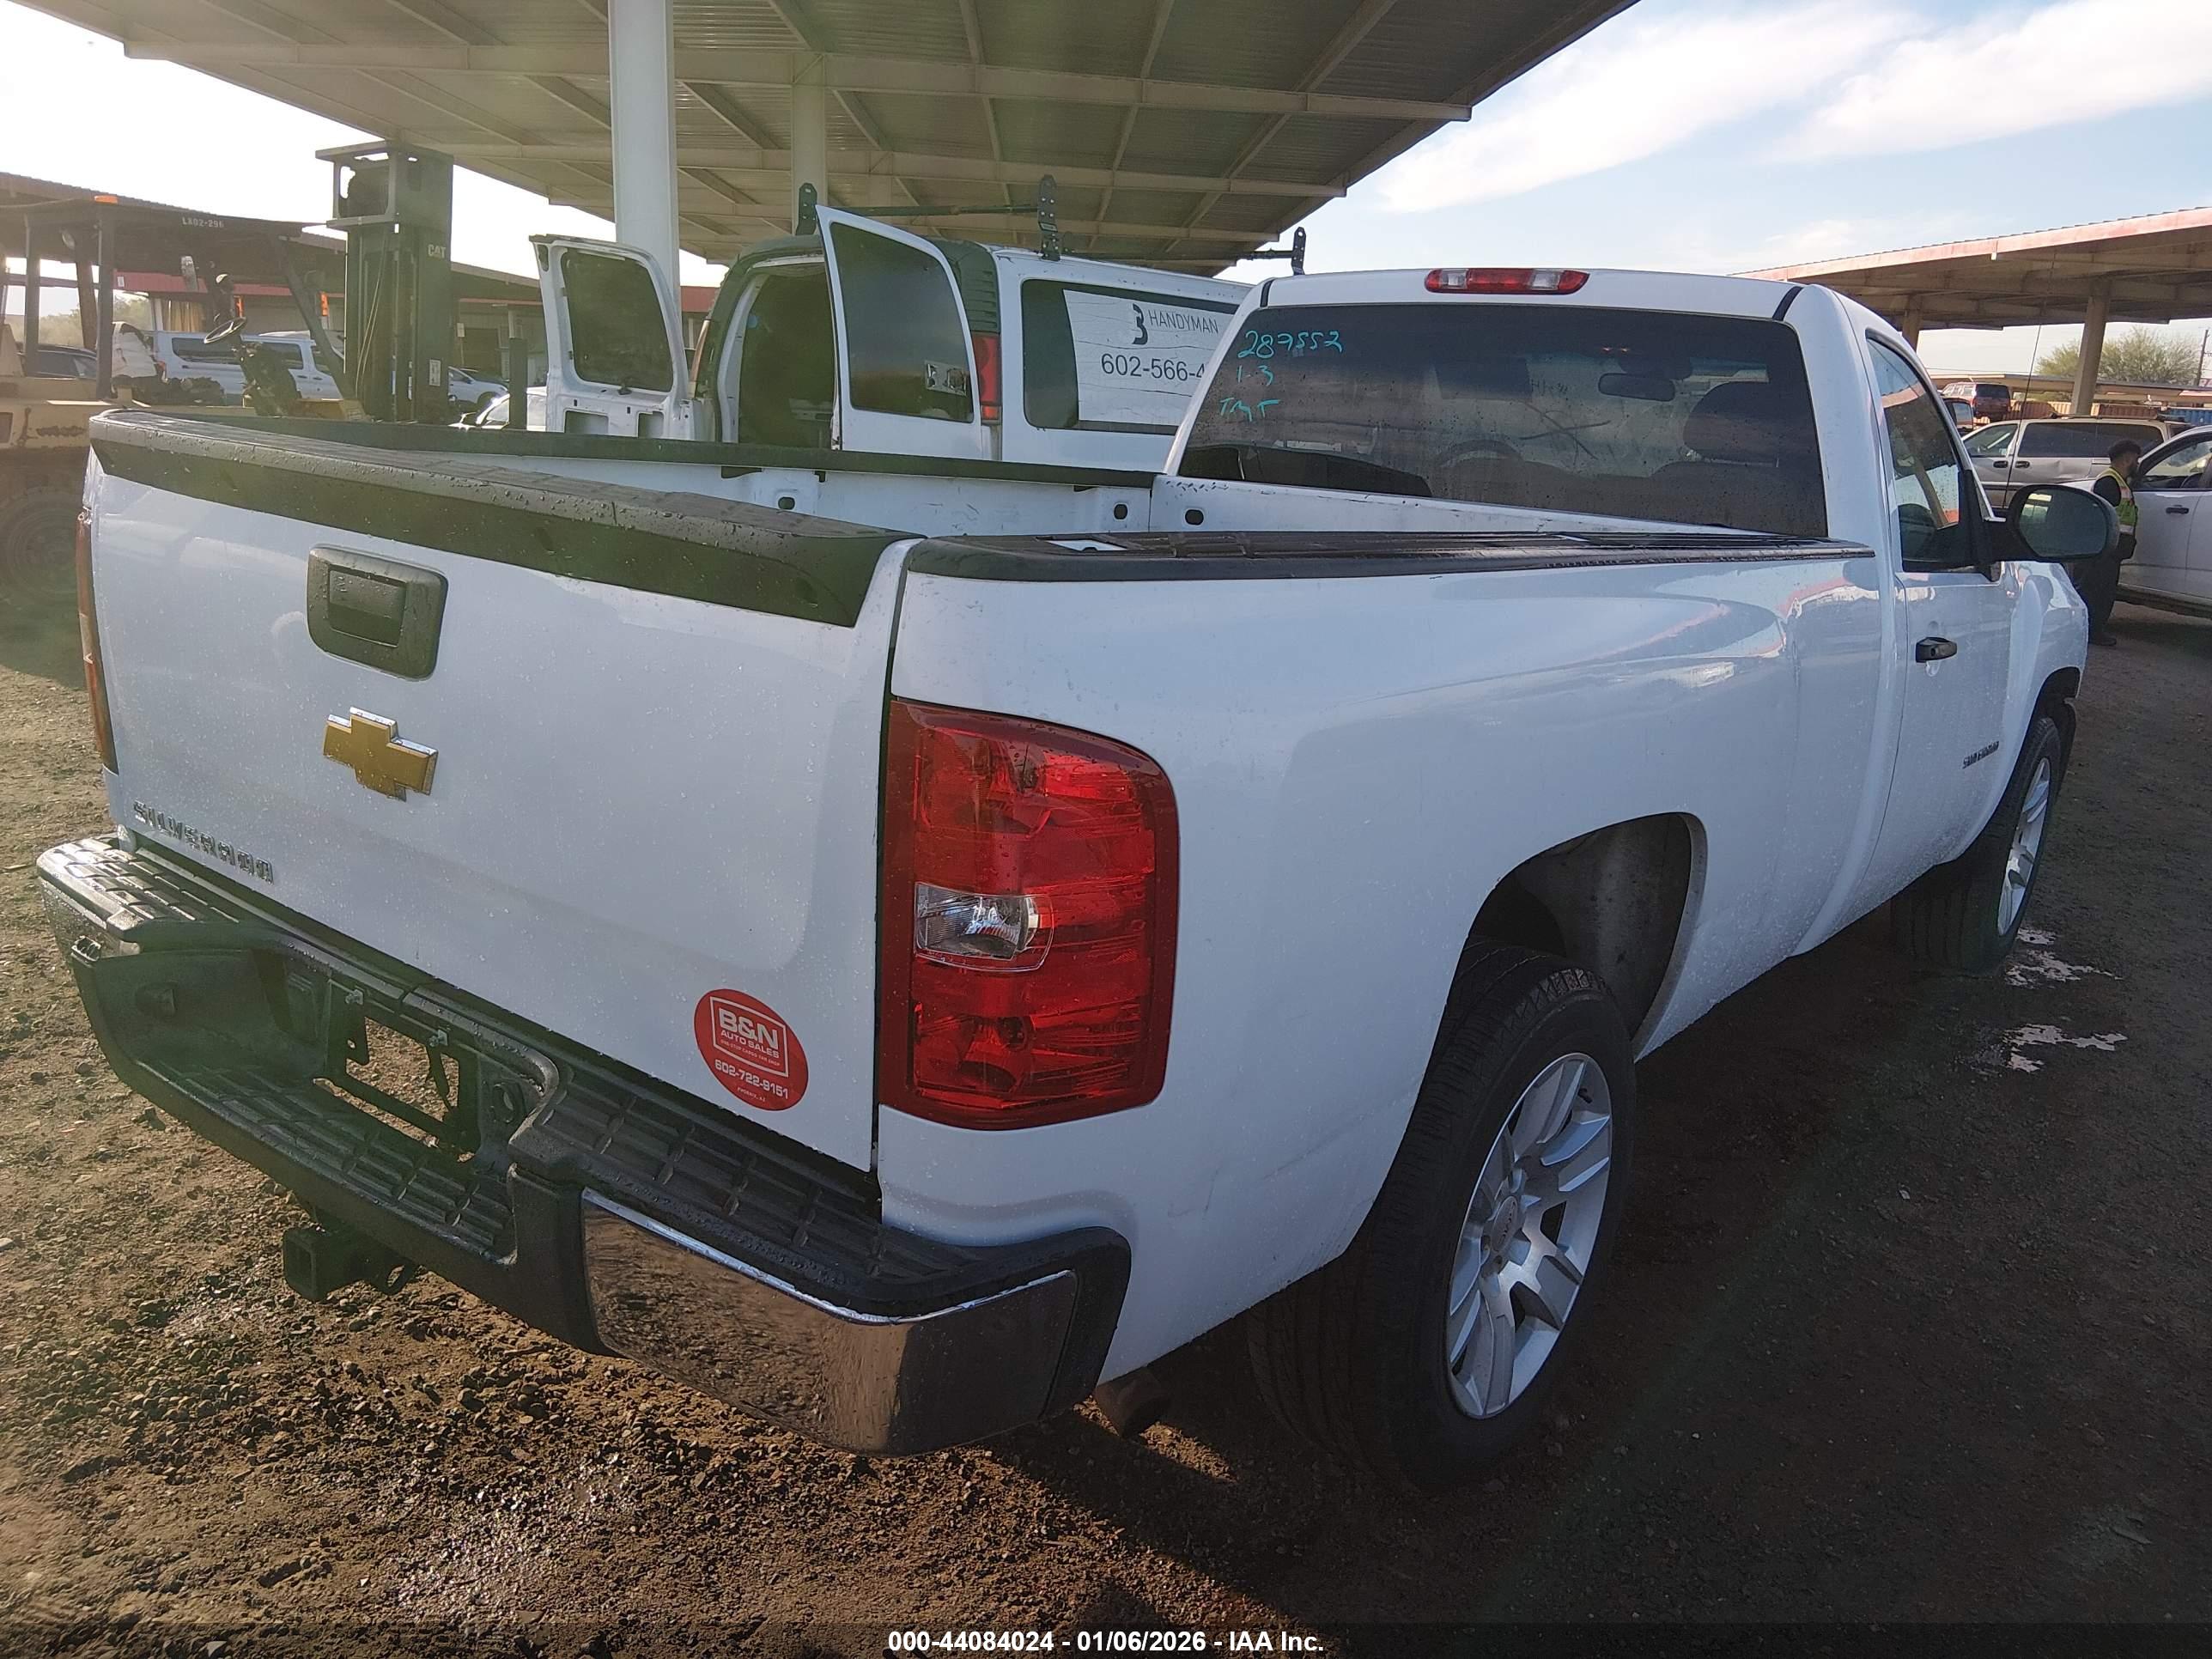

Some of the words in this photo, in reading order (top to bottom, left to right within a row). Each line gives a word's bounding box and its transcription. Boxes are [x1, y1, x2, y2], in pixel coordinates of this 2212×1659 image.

[428, 244, 447, 258] CAT
[1148, 309, 1218, 334] HANDYMAN
[719, 1007, 780, 1050] B&N
[720, 1030, 747, 1046] AUTO
[747, 1040, 780, 1059] SALES
[714, 1058, 788, 1100] 602-722-9151
